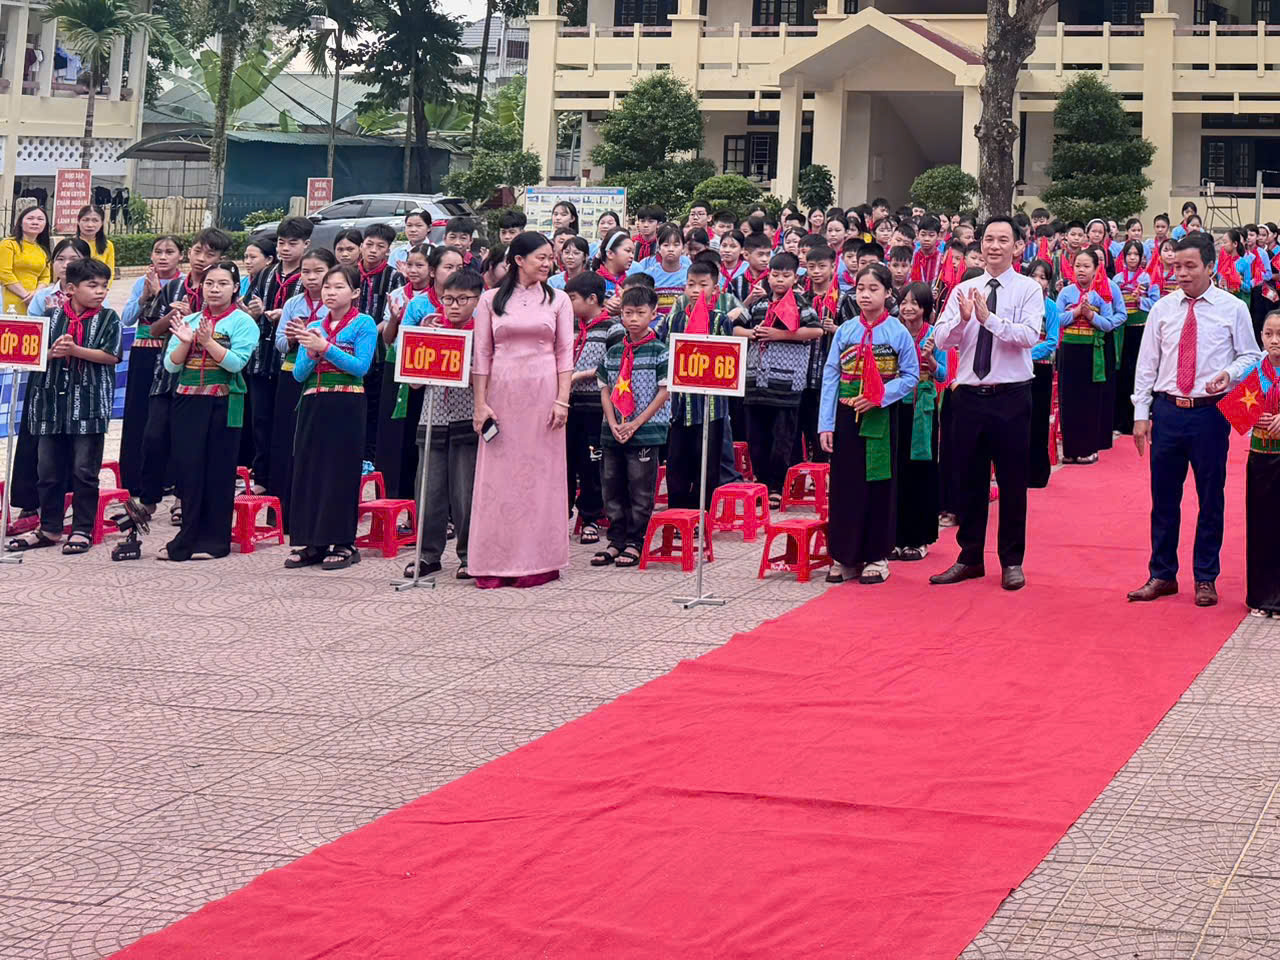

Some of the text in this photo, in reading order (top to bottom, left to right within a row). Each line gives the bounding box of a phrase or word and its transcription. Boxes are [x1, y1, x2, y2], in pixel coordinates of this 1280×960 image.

[0, 327, 39, 357] ỚP 8B
[404, 341, 461, 373] LỚP 7B
[678, 346, 736, 380] LỚP 6B
